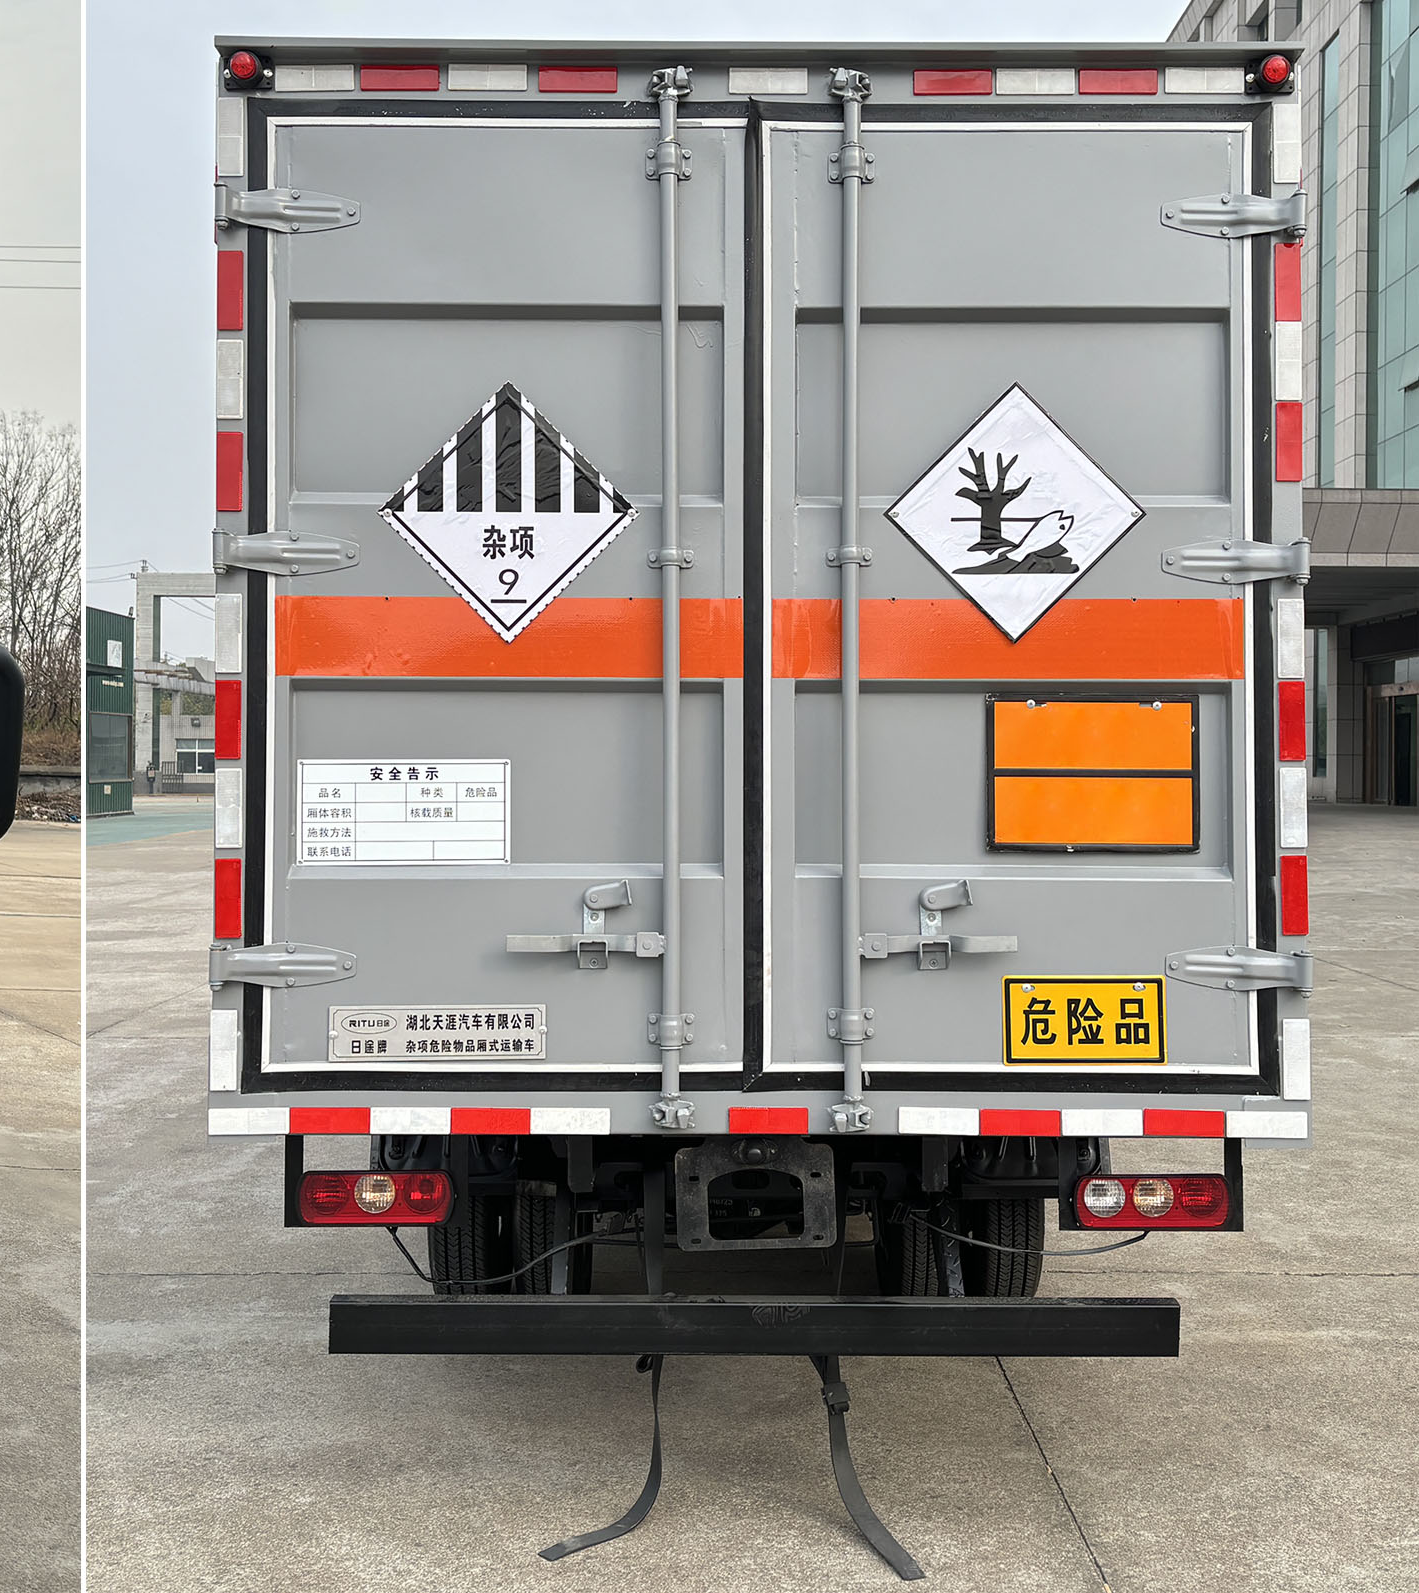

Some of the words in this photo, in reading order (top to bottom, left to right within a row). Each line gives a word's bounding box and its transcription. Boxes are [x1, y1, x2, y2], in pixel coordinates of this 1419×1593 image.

[482, 525, 535, 559] 杂项
[498, 568, 519, 595] 9
[370, 766, 439, 781] 安全告示
[318, 787, 341, 798] 品名
[420, 787, 444, 798] 种类
[465, 786, 497, 798] 危险品
[307, 807, 352, 818] 厢体容积
[410, 806, 454, 818] 核载质量
[307, 827, 352, 838] 施救方法
[307, 846, 352, 858] 联系电话
[405, 1013, 535, 1031] 湖北天涯汽车有限公司
[1021, 997, 1150, 1046] 危险品
[351, 1039, 387, 1054] 日途牌
[405, 1038, 535, 1054] 杂项危险物品厢式运输车
